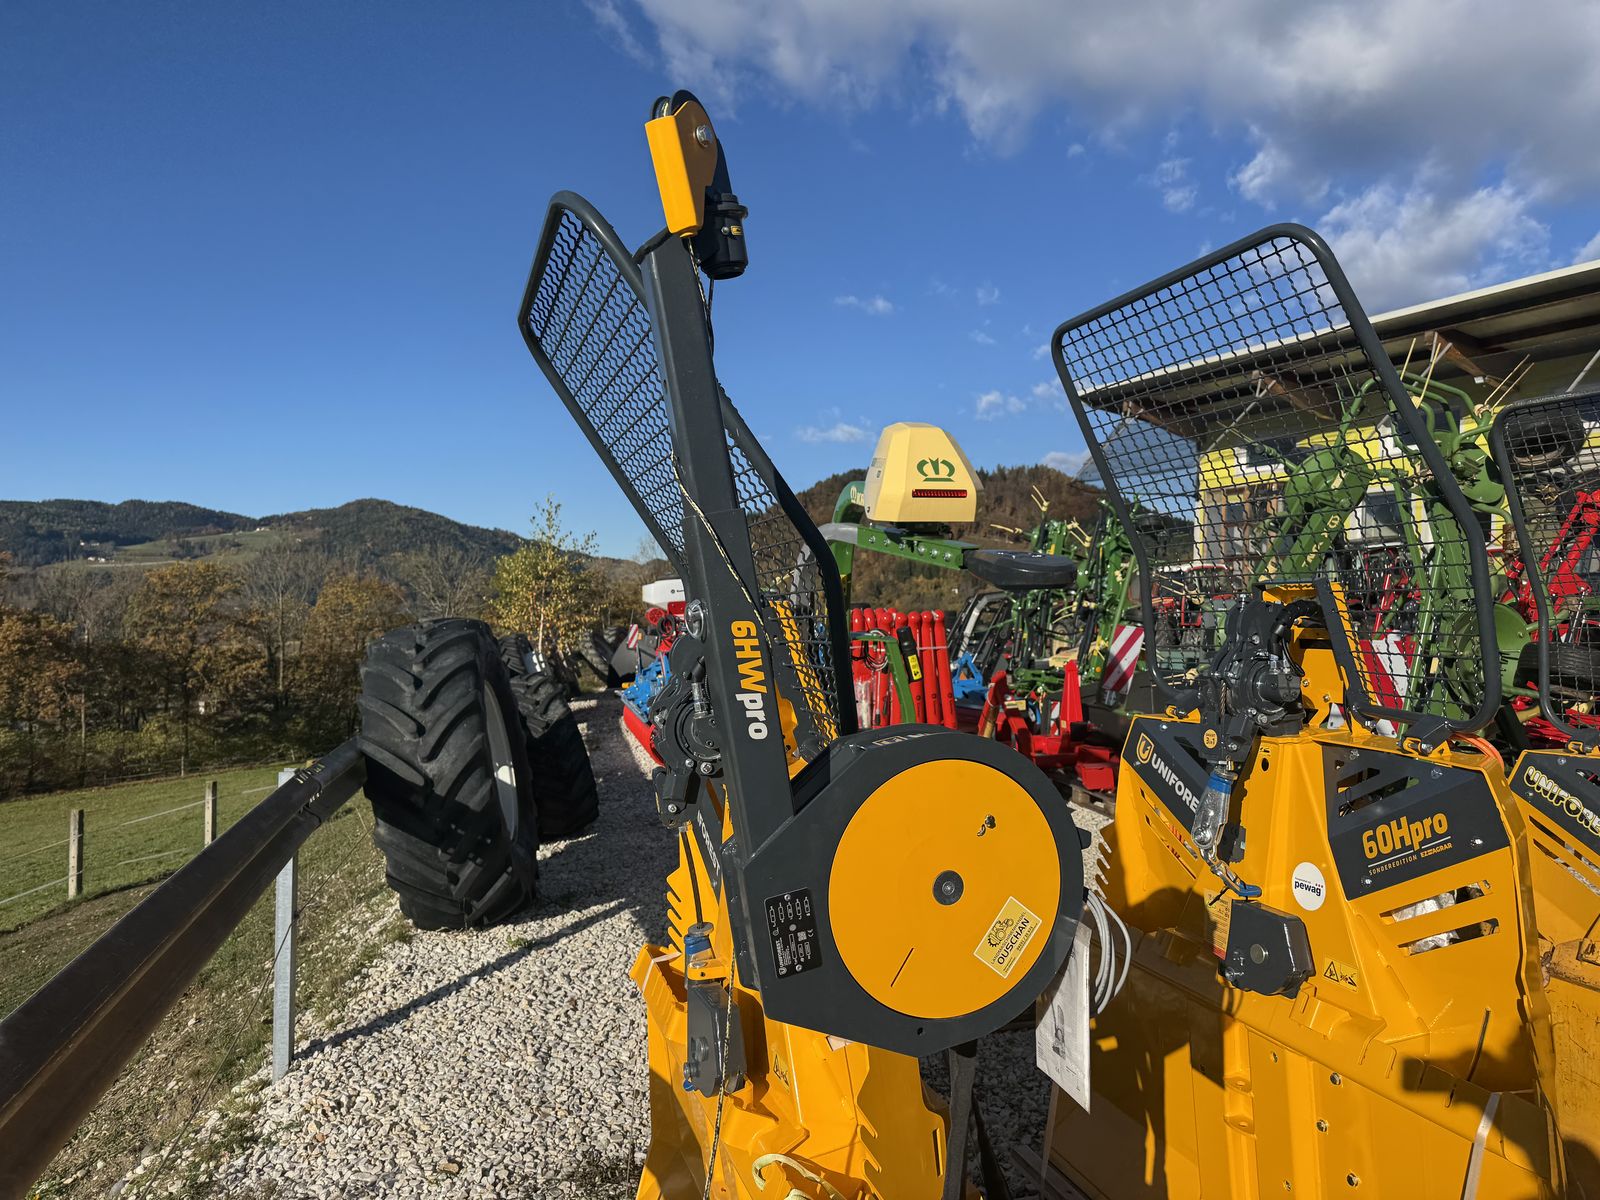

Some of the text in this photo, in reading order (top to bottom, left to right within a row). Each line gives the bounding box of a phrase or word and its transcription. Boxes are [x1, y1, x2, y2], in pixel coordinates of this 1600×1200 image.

[731, 620, 768, 740] 6HWpro
[1362, 813, 1448, 859] 60Hpro
[1368, 855, 1418, 876] SONDEREDITION
[1294, 881, 1321, 897] pewag
[997, 918, 1030, 965] OUSCHAN
